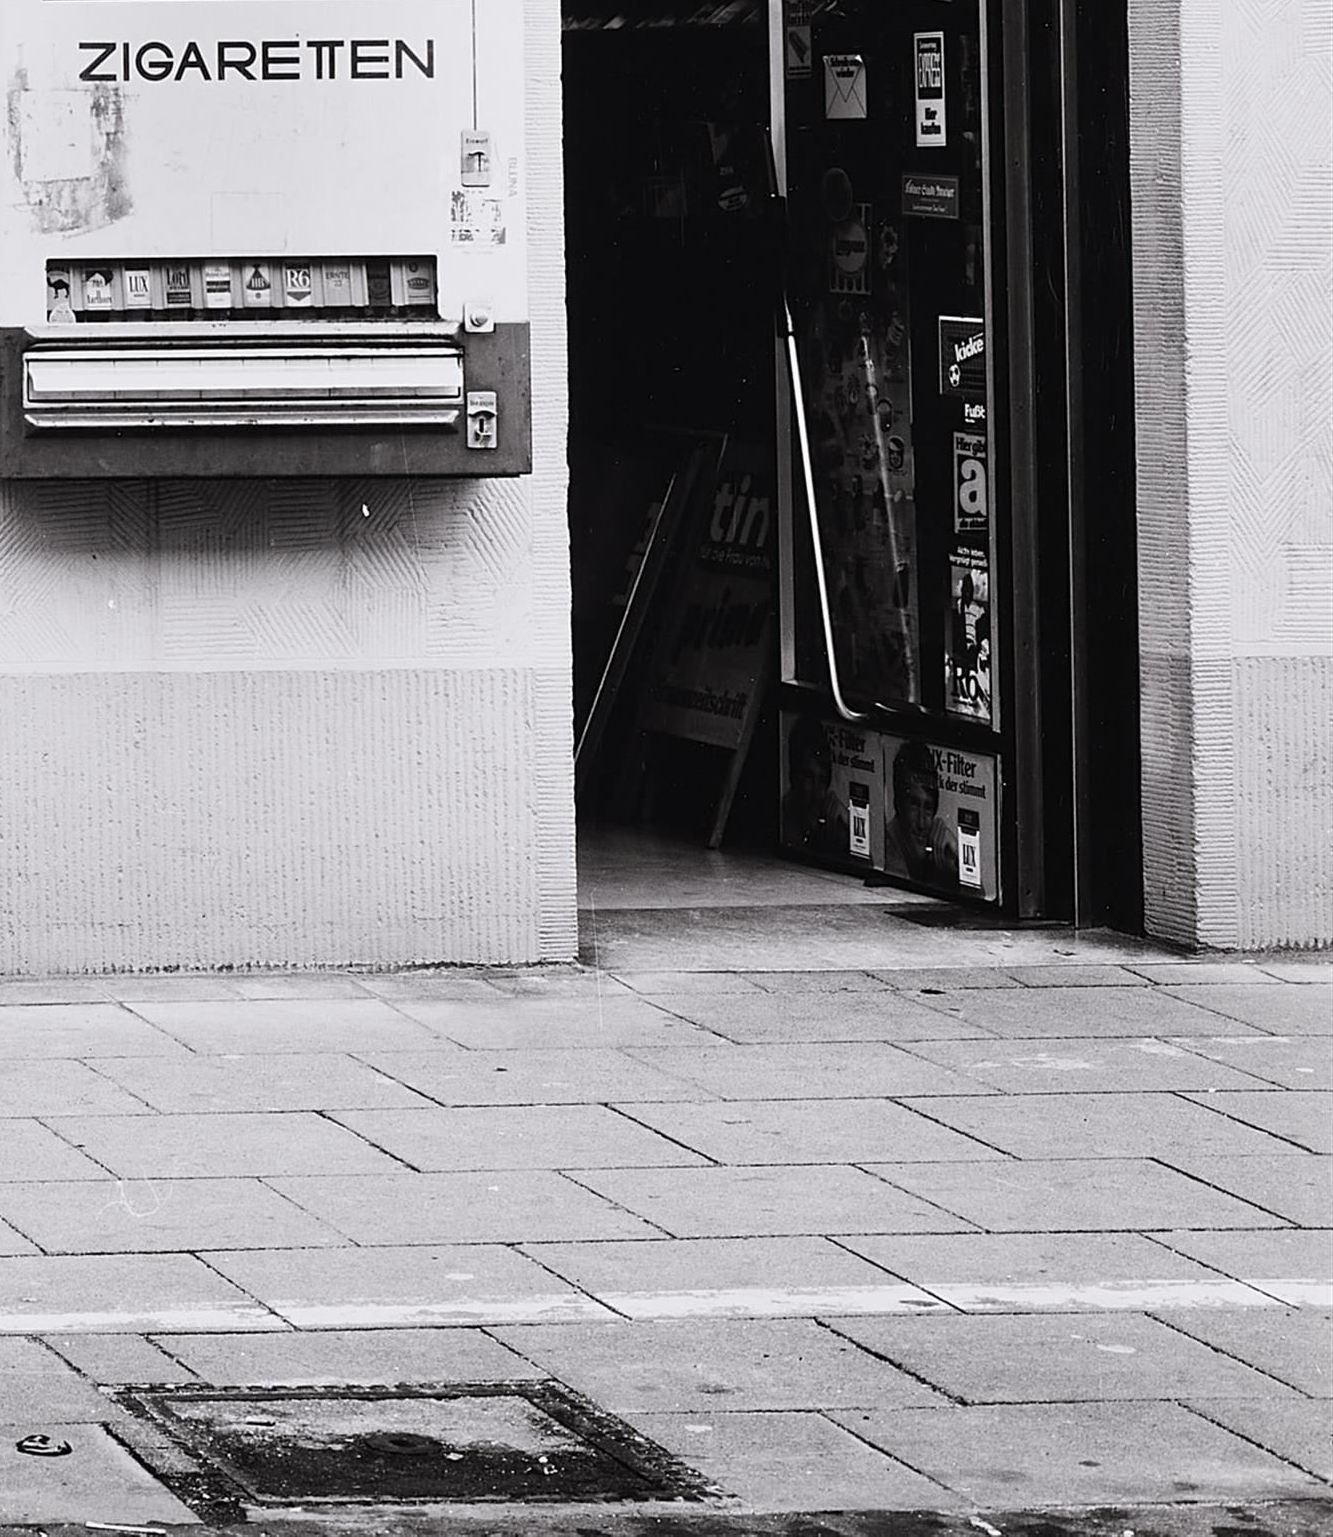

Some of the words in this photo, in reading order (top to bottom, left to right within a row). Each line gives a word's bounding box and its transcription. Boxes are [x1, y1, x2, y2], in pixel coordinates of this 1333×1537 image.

[78, 39, 435, 82] ZIGARETTEN
[128, 276, 148, 292] LUX
[251, 278, 264, 287] HB
[287, 269, 310, 288] R6
